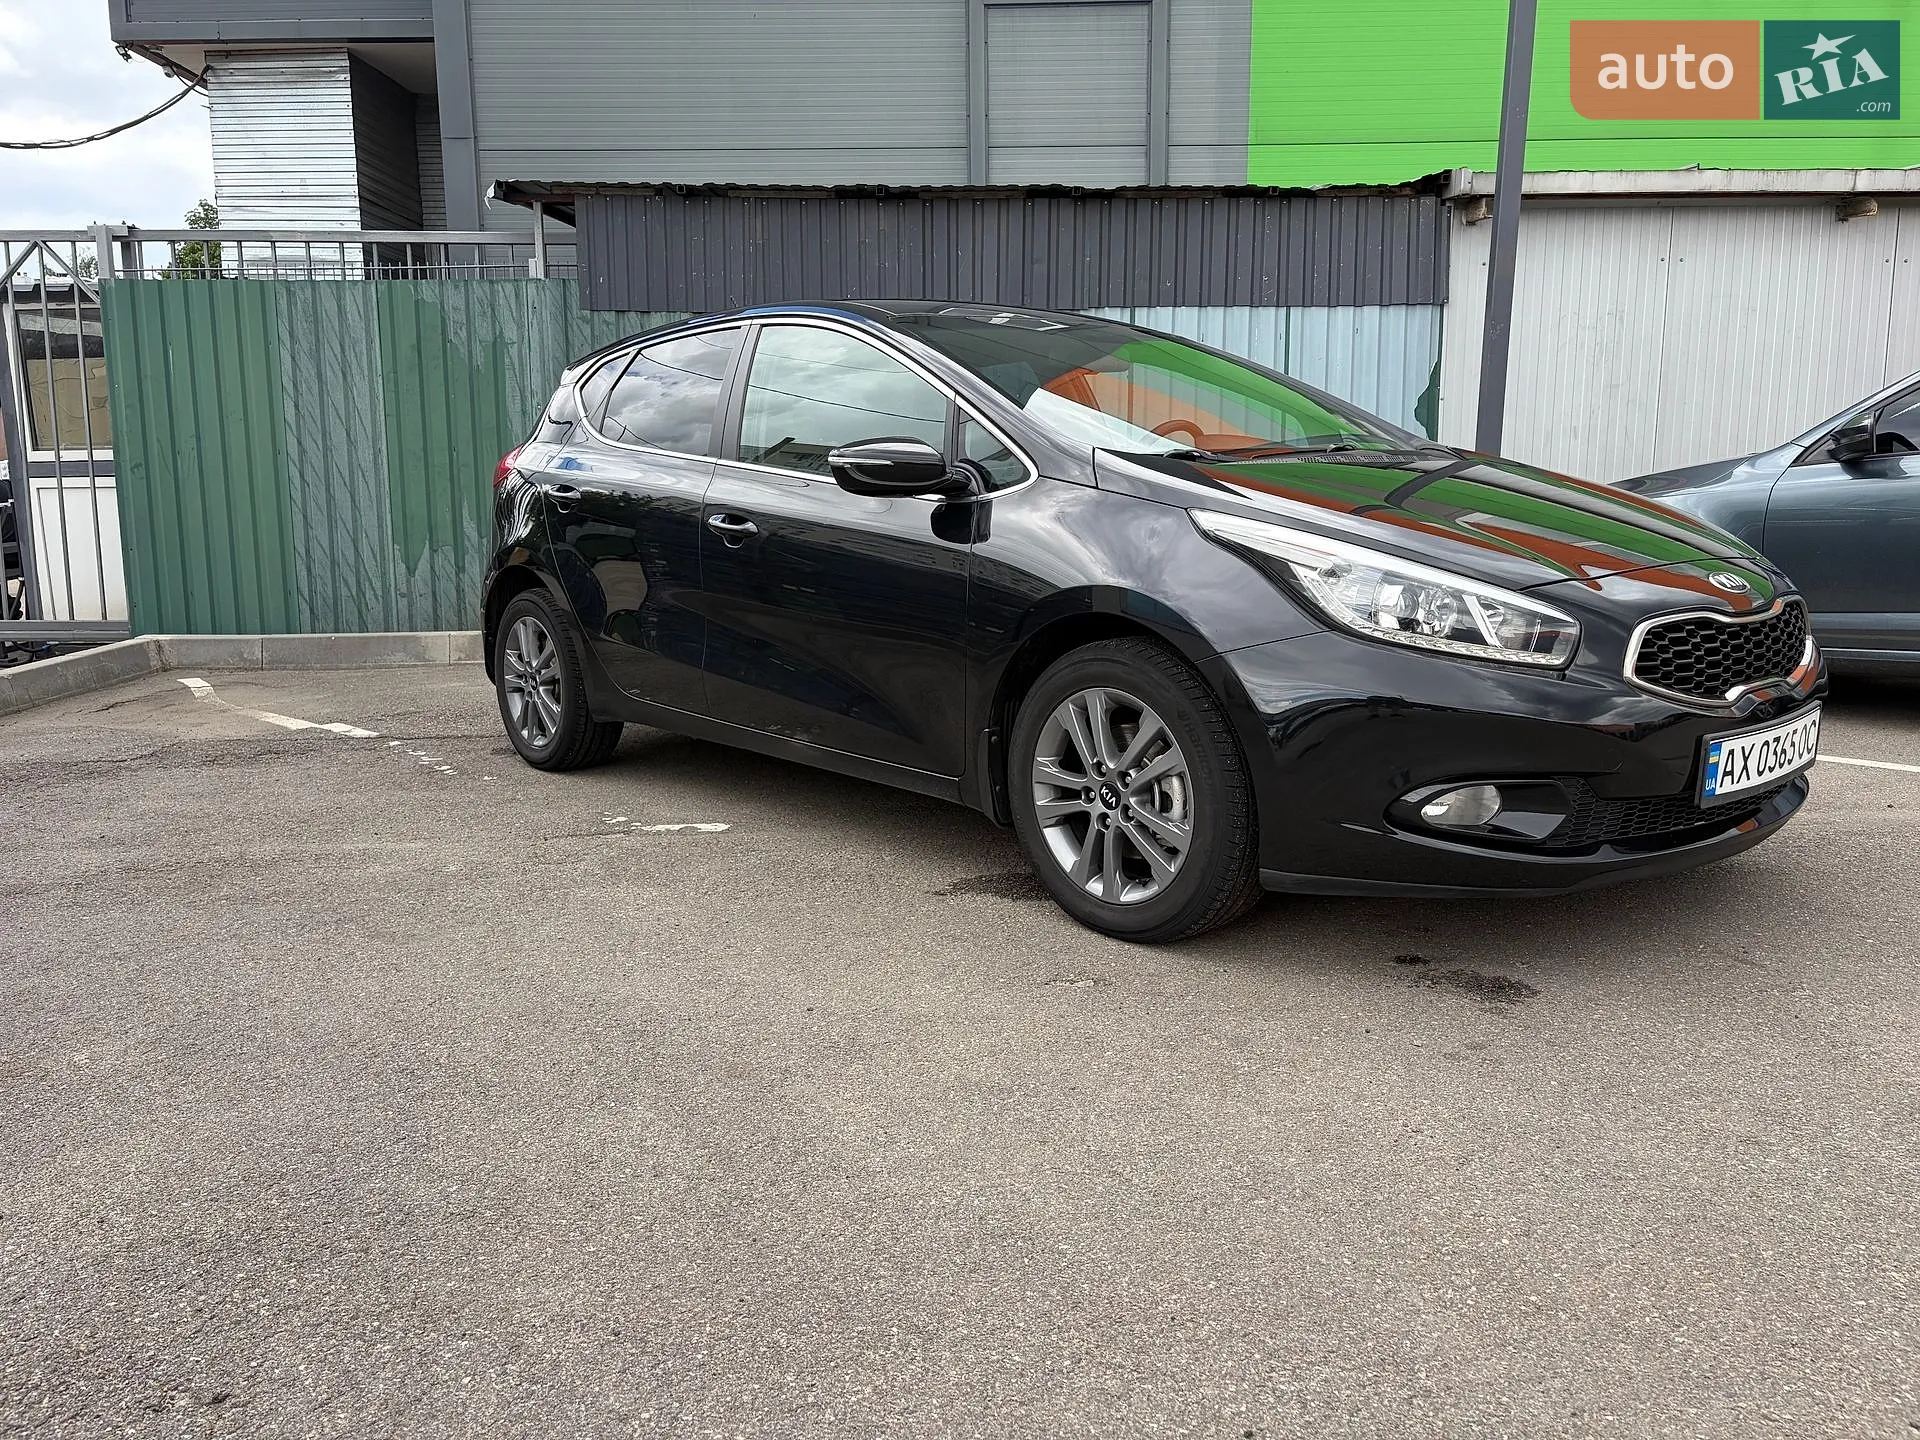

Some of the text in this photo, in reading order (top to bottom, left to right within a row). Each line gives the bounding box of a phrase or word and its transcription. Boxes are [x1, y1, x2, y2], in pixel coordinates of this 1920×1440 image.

[1719, 719, 1816, 788] AX 0365 OC
[1705, 778, 1716, 791] UA
[1100, 785, 1116, 808] KIA
